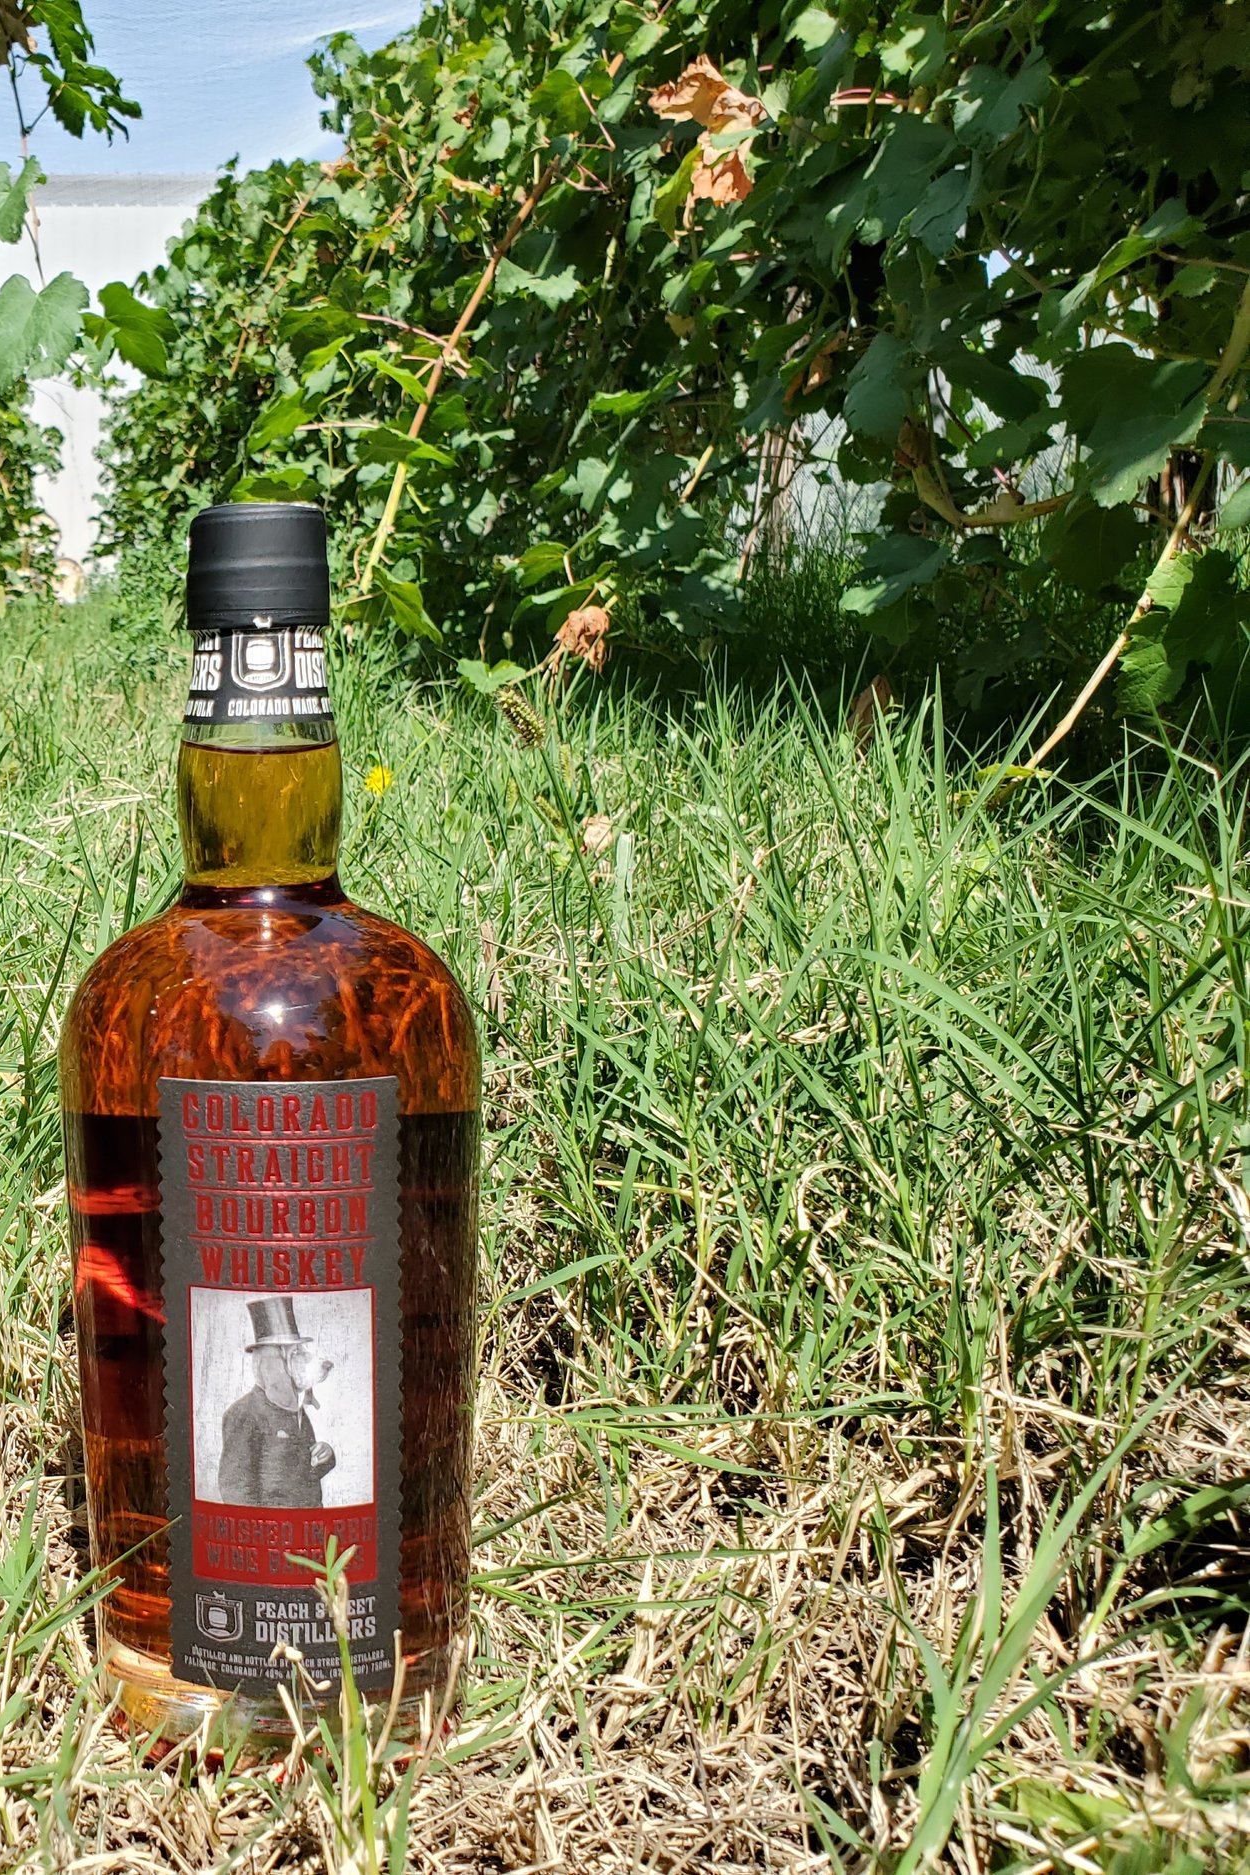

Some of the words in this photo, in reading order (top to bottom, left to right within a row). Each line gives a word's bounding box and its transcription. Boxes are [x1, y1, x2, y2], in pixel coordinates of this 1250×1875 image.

[227, 697, 289, 717] COLORADO
[181, 1091, 378, 1134] COLORADO
[187, 1143, 375, 1186] STRAIGHT
[195, 1194, 367, 1238] BOURBON
[200, 1245, 366, 1287] WHISKEY
[194, 1513, 294, 1546] FINISHED
[303, 1520, 325, 1547] IN
[332, 1516, 373, 1546] RED
[206, 1541, 259, 1574] WINE
[255, 1601, 310, 1619] PEACH
[314, 1596, 376, 1619] SEET
[221, 1663, 257, 1677] COLORADO
[229, 1653, 243, 1664] AND
[317, 1656, 342, 1668] STREE
[349, 1649, 385, 1665] ISTILLERS
